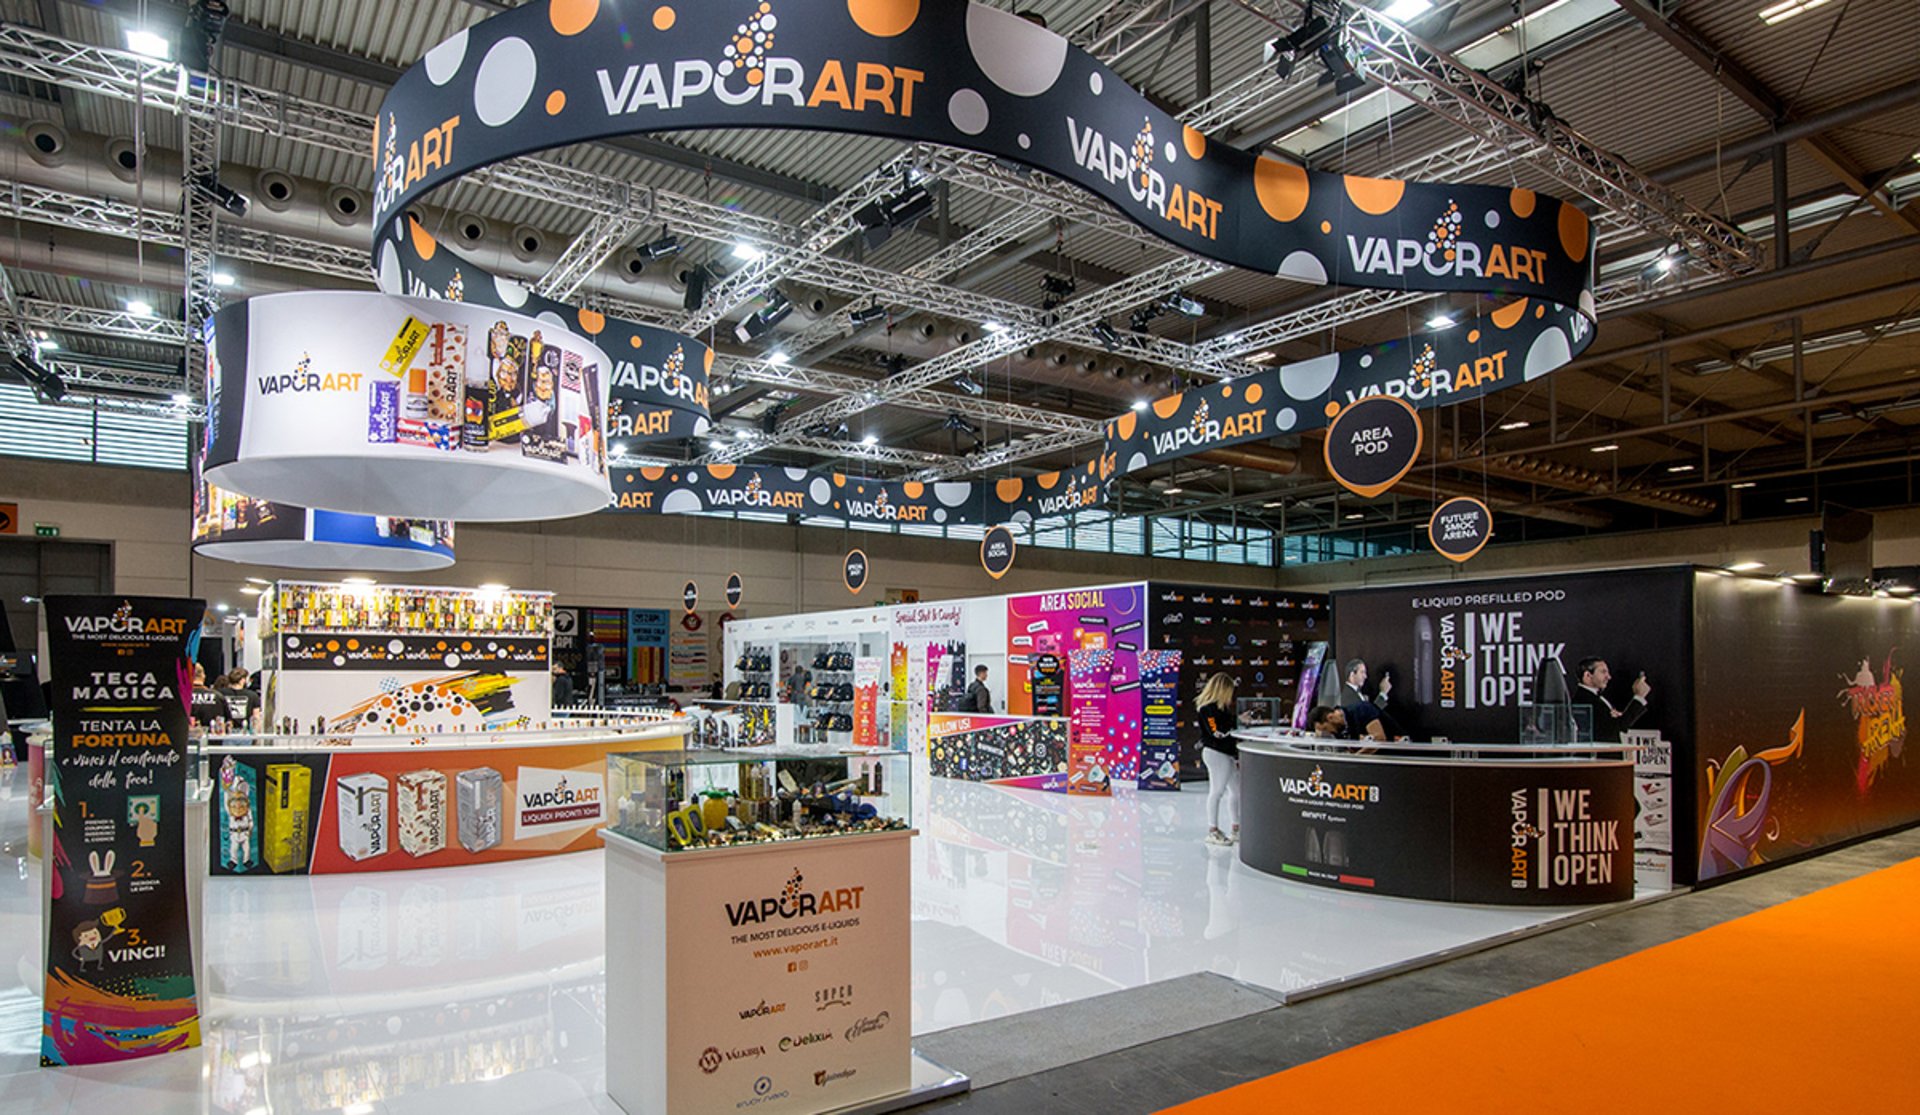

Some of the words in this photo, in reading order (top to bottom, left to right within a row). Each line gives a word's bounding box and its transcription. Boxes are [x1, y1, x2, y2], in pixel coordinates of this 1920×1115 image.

[597, 57, 925, 117] VAPORART
[1067, 117, 1223, 240] VAPORART
[1347, 235, 1548, 285] VAPORART
[258, 374, 362, 395] VAPORART
[1152, 409, 1266, 455] VAPORART
[1351, 427, 1393, 444] AREA
[1355, 441, 1389, 456] POD
[706, 489, 804, 508] VAPORART
[1038, 485, 1098, 514] VAPORART
[846, 499, 928, 521] VAPORART
[1441, 511, 1479, 524] FUTURE
[1443, 529, 1479, 541] ARENA
[1445, 520, 1475, 532] SMOC
[1040, 594, 1066, 612] AREA
[1067, 590, 1105, 609] SOCIAL
[1412, 596, 1462, 609] E-LIQUID
[1465, 592, 1532, 605] PREFILLED
[1535, 590, 1566, 601] POD
[65, 616, 186, 634] VAPORART
[1480, 612, 1523, 643] WE
[1440, 613, 1455, 697] VAPORART
[1480, 643, 1567, 675] THINK
[91, 672, 158, 685] TECA
[72, 687, 174, 700] MAGICA
[80, 720, 137, 732] TENTA
[141, 719, 161, 731] LA
[72, 733, 172, 748] FORTUNA
[72, 753, 107, 767] vinci
[108, 749, 118, 768] il
[121, 749, 180, 768] contenuto
[88, 770, 117, 788] della
[126, 769, 153, 789] teca!
[1279, 777, 1369, 801] VAPORART
[523, 787, 600, 808] VAPORART
[1553, 789, 1592, 821] WE
[78, 802, 95, 818] 1.
[429, 789, 440, 850] VAPORART
[523, 811, 552, 823] LIQUIDI
[555, 809, 582, 820] PRONTI
[371, 793, 382, 855] VAPORART
[1511, 788, 1528, 879] VAPORART
[1553, 820, 1620, 853] THINK
[131, 860, 151, 877] 2.
[1553, 853, 1613, 886] OPEN
[725, 886, 865, 927] VAPORART
[127, 929, 147, 945] 3.
[731, 935, 748, 944] THE
[750, 931, 775, 942] MOST
[777, 923, 820, 938] DELICIOUS
[821, 918, 860, 931] E-LIQUIDS
[108, 945, 166, 963] VINCI!
[753, 936, 838, 959] www.vaporart.it
[739, 1002, 786, 1020] VAPORART
